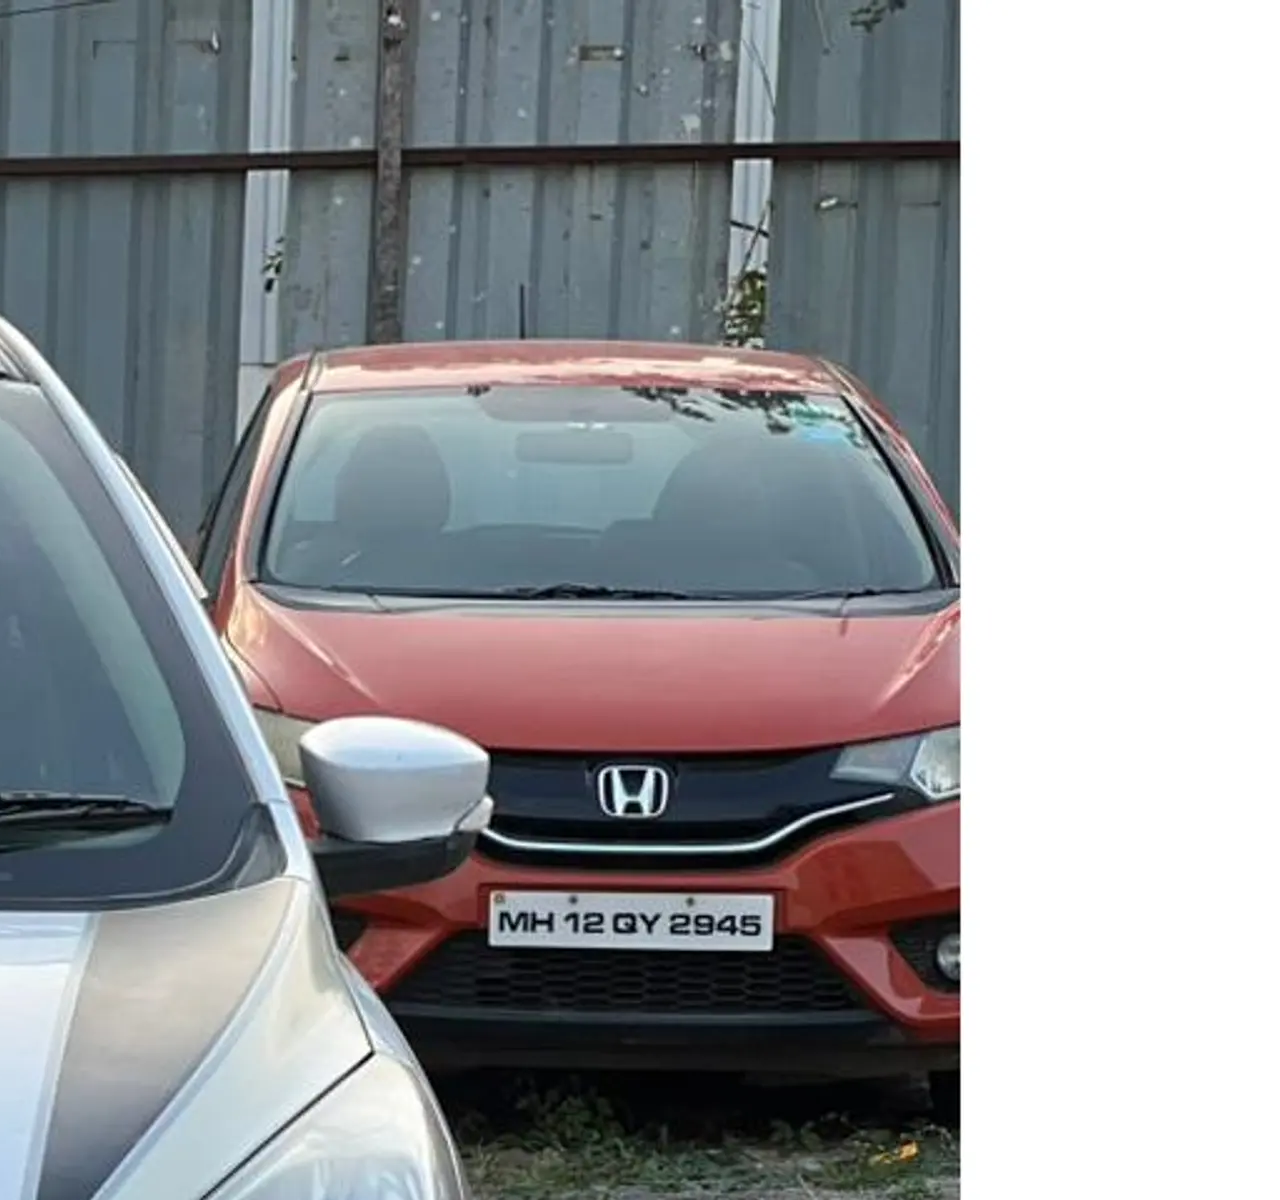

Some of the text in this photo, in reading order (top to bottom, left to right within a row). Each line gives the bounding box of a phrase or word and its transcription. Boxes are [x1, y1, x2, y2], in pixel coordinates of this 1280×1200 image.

[498, 911, 762, 937] MH 12 QY 2945
